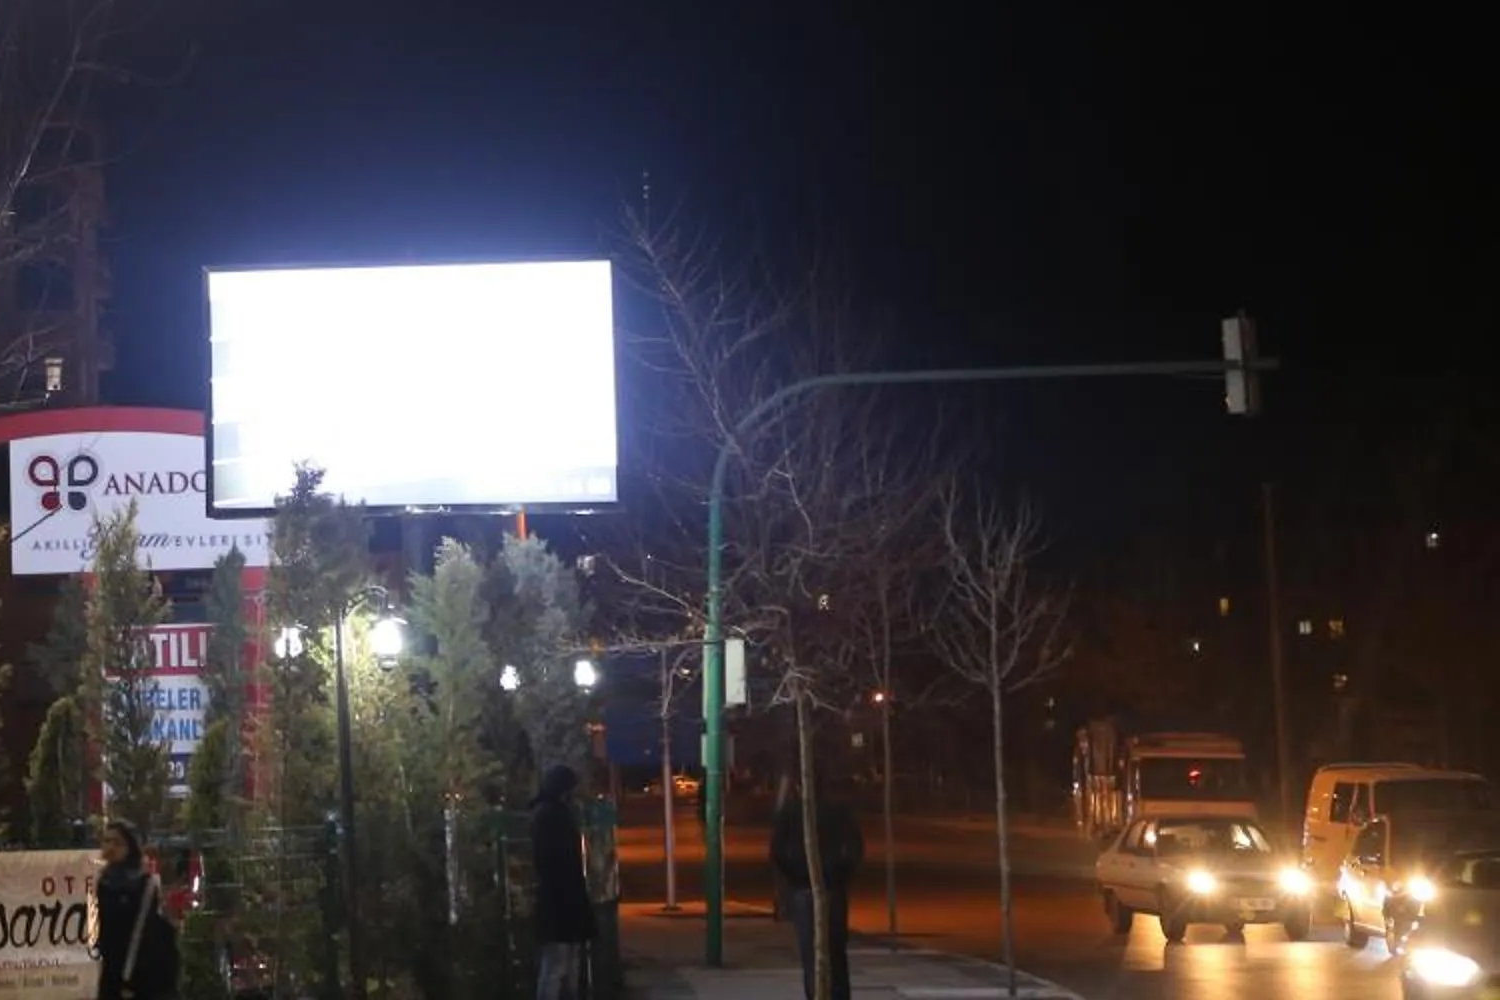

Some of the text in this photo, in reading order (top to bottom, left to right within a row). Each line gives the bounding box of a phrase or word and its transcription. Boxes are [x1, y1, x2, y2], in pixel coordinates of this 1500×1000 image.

[104, 470, 207, 497] ANADO
[148, 631, 208, 668] TILI
[150, 717, 202, 741] KANL
[42, 875, 94, 897] OTE
